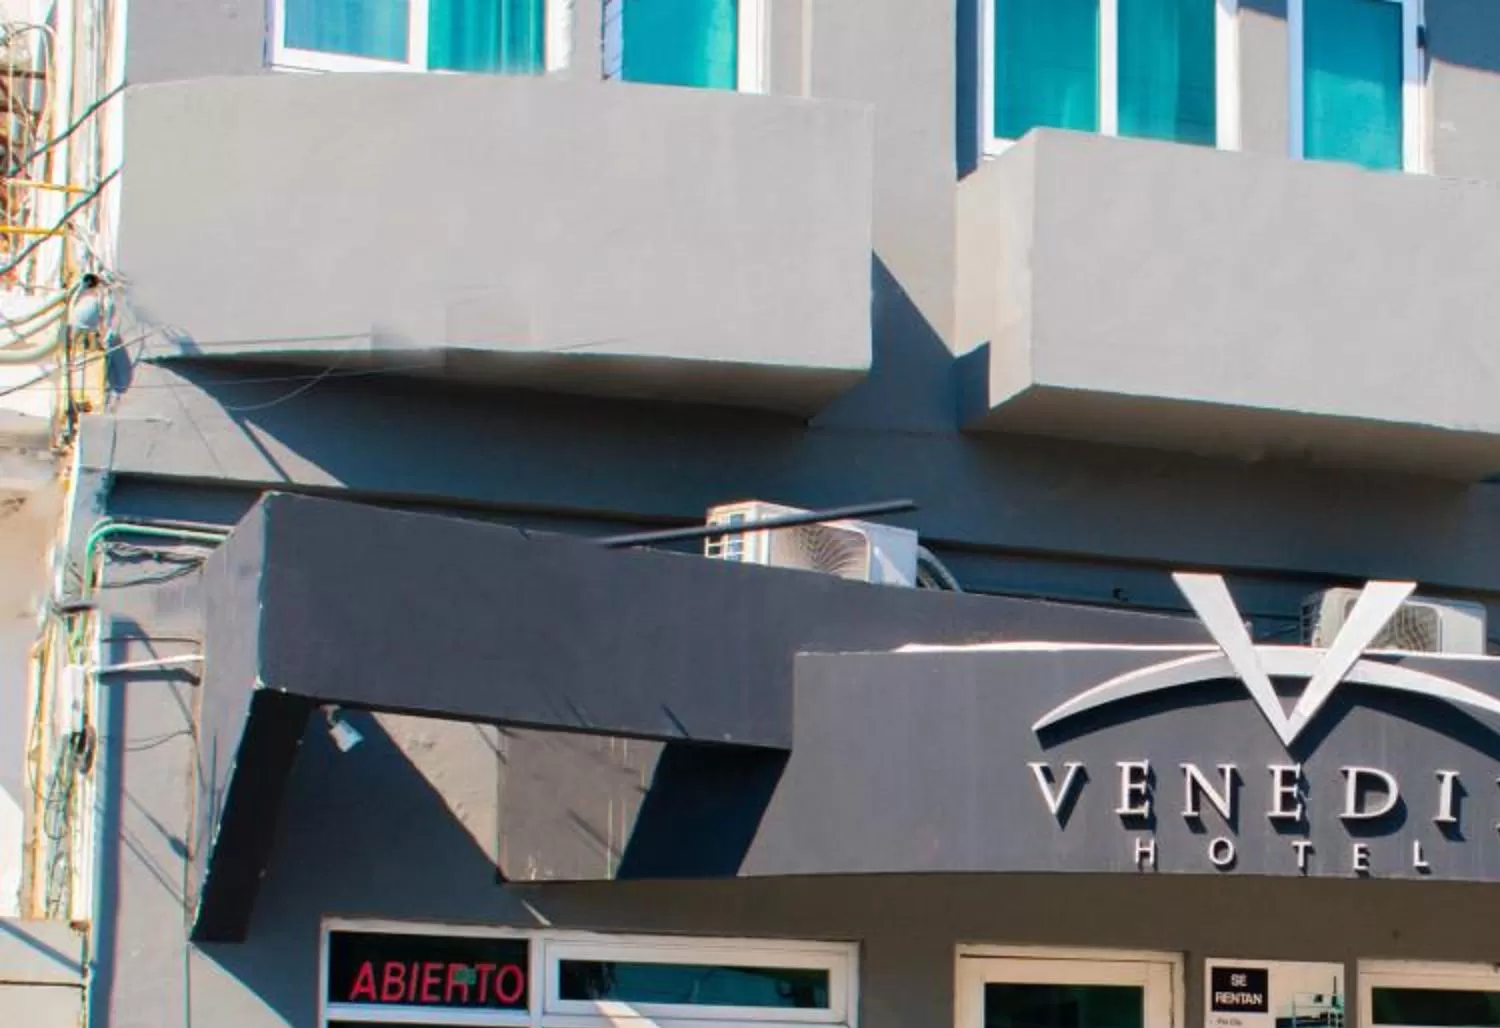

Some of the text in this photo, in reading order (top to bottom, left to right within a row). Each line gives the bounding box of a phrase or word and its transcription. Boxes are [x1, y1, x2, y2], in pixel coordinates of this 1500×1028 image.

[1134, 838, 1430, 870] HOTEL
[350, 960, 525, 1004] ABIERTO
[1215, 991, 1263, 1006] RENTAN
